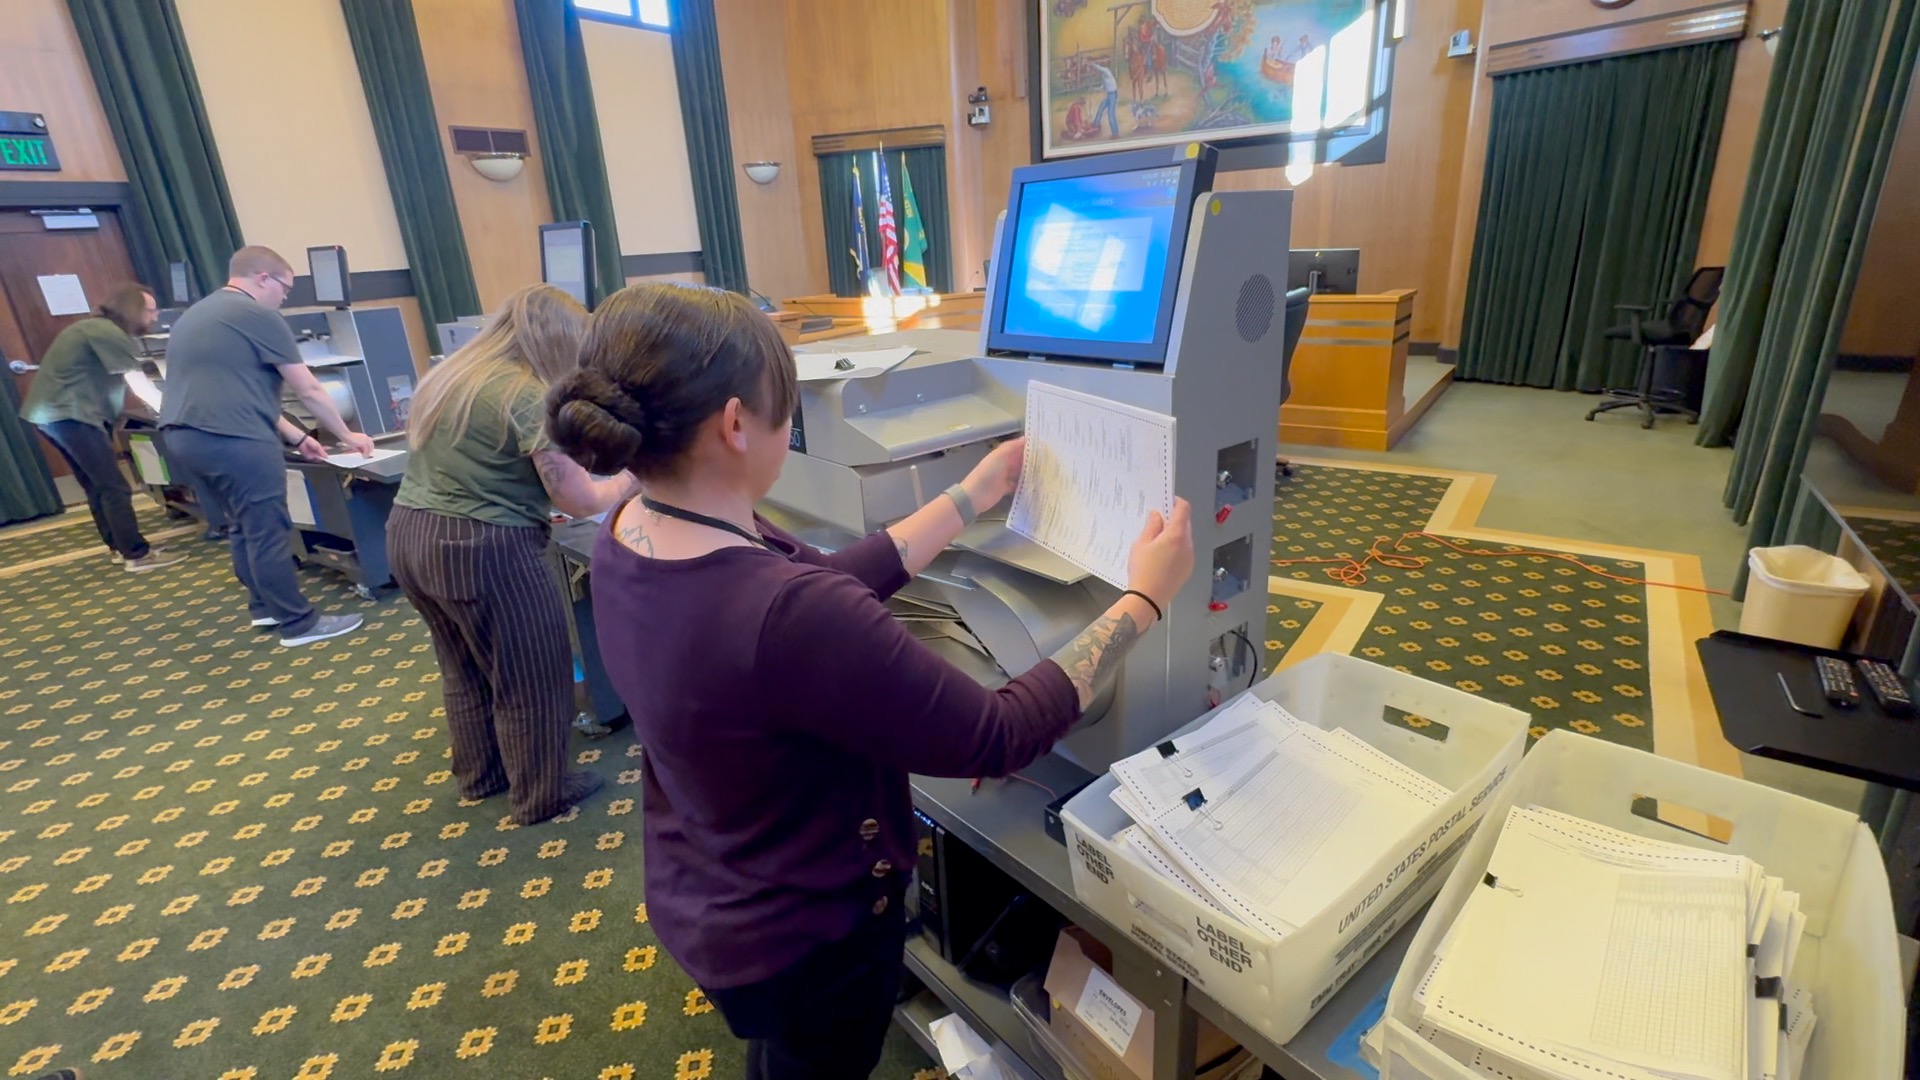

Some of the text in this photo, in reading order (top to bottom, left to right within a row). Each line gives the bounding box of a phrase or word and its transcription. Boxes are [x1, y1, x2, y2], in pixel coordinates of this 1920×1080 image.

[0, 138, 48, 165] EXIT
[1074, 832, 1112, 868] LABEL
[1076, 843, 1115, 880] OTHER
[1337, 883, 1384, 934] UNITED
[1385, 841, 1427, 889] STATES
[1427, 805, 1466, 850] POSTAL
[1468, 764, 1508, 812] SERVICE
[1085, 860, 1109, 885] END
[1132, 924, 1199, 976] UNITED STATES
[1196, 915, 1251, 956] LABEL
[1197, 929, 1252, 968] OTHER
[1130, 929, 1205, 986] POSTAL SERVICE
[1209, 947, 1243, 973] END
[1099, 988, 1127, 1017] ENVELOPES
